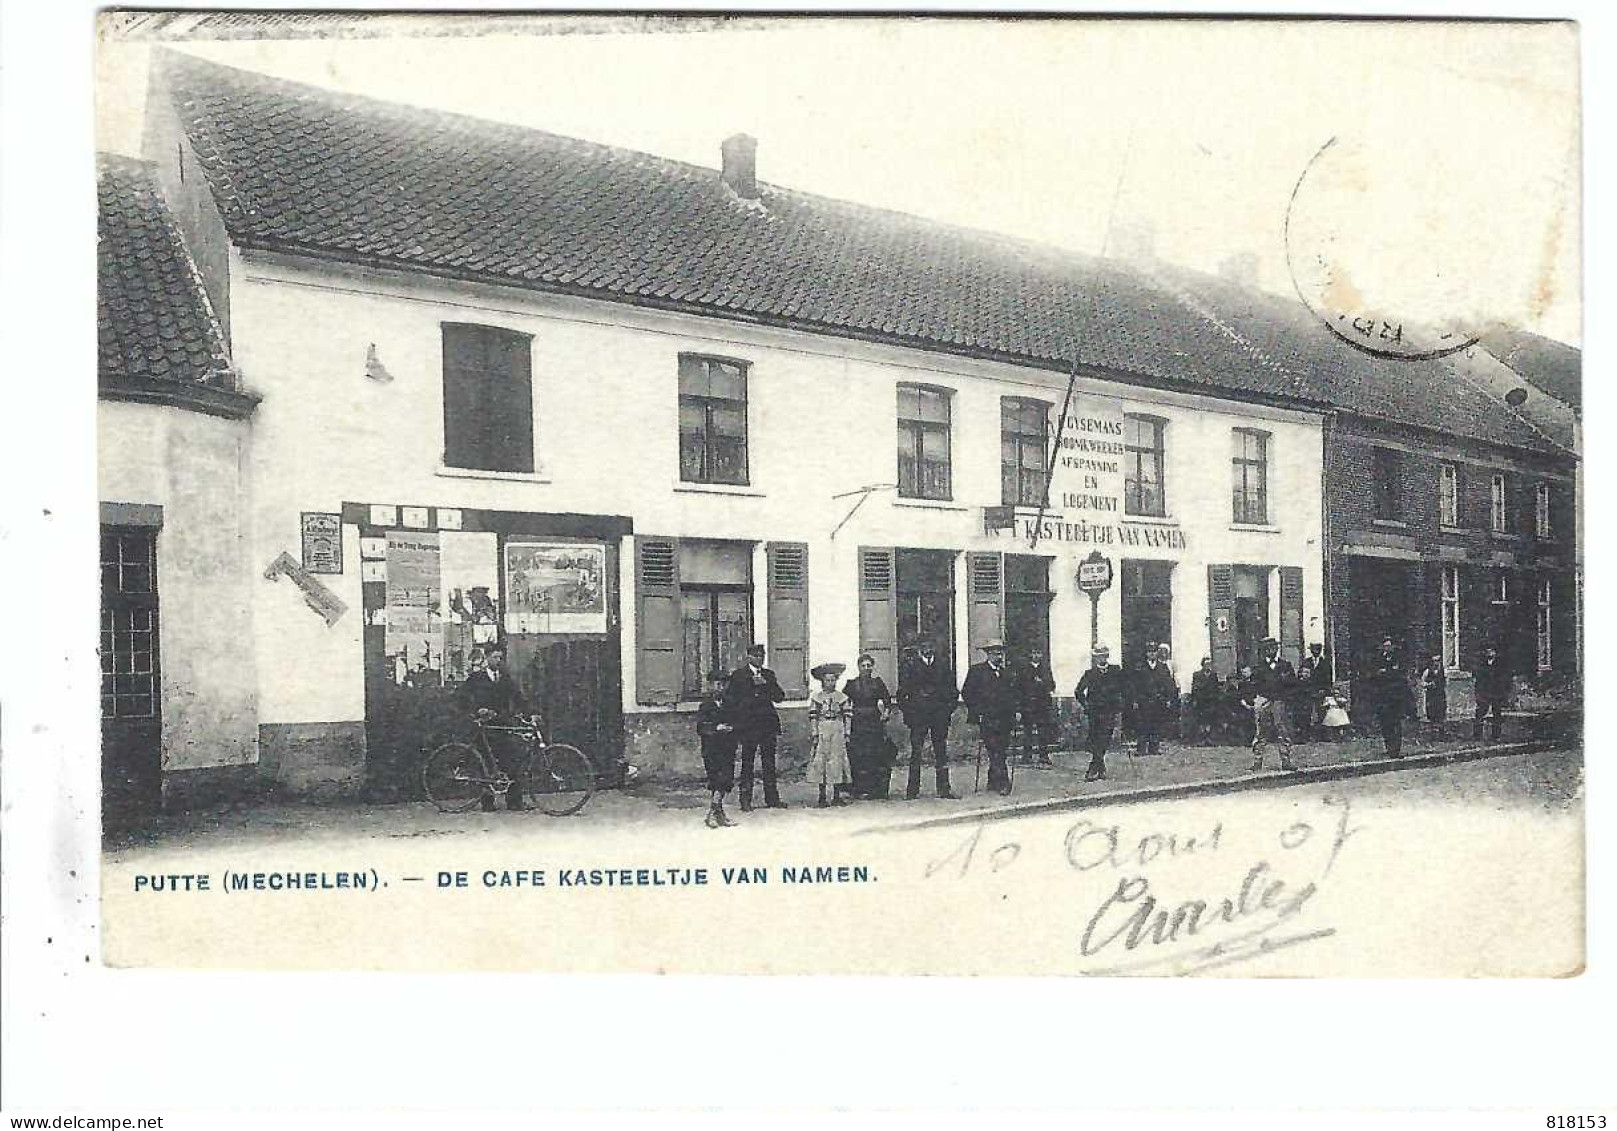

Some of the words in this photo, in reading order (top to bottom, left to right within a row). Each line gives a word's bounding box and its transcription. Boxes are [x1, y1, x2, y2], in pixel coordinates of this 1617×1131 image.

[1084, 475, 1098, 490] EN
[1063, 491, 1118, 512] LOGEMENT
[1117, 525, 1140, 546] VAN
[1144, 528, 1186, 550] NAMEN
